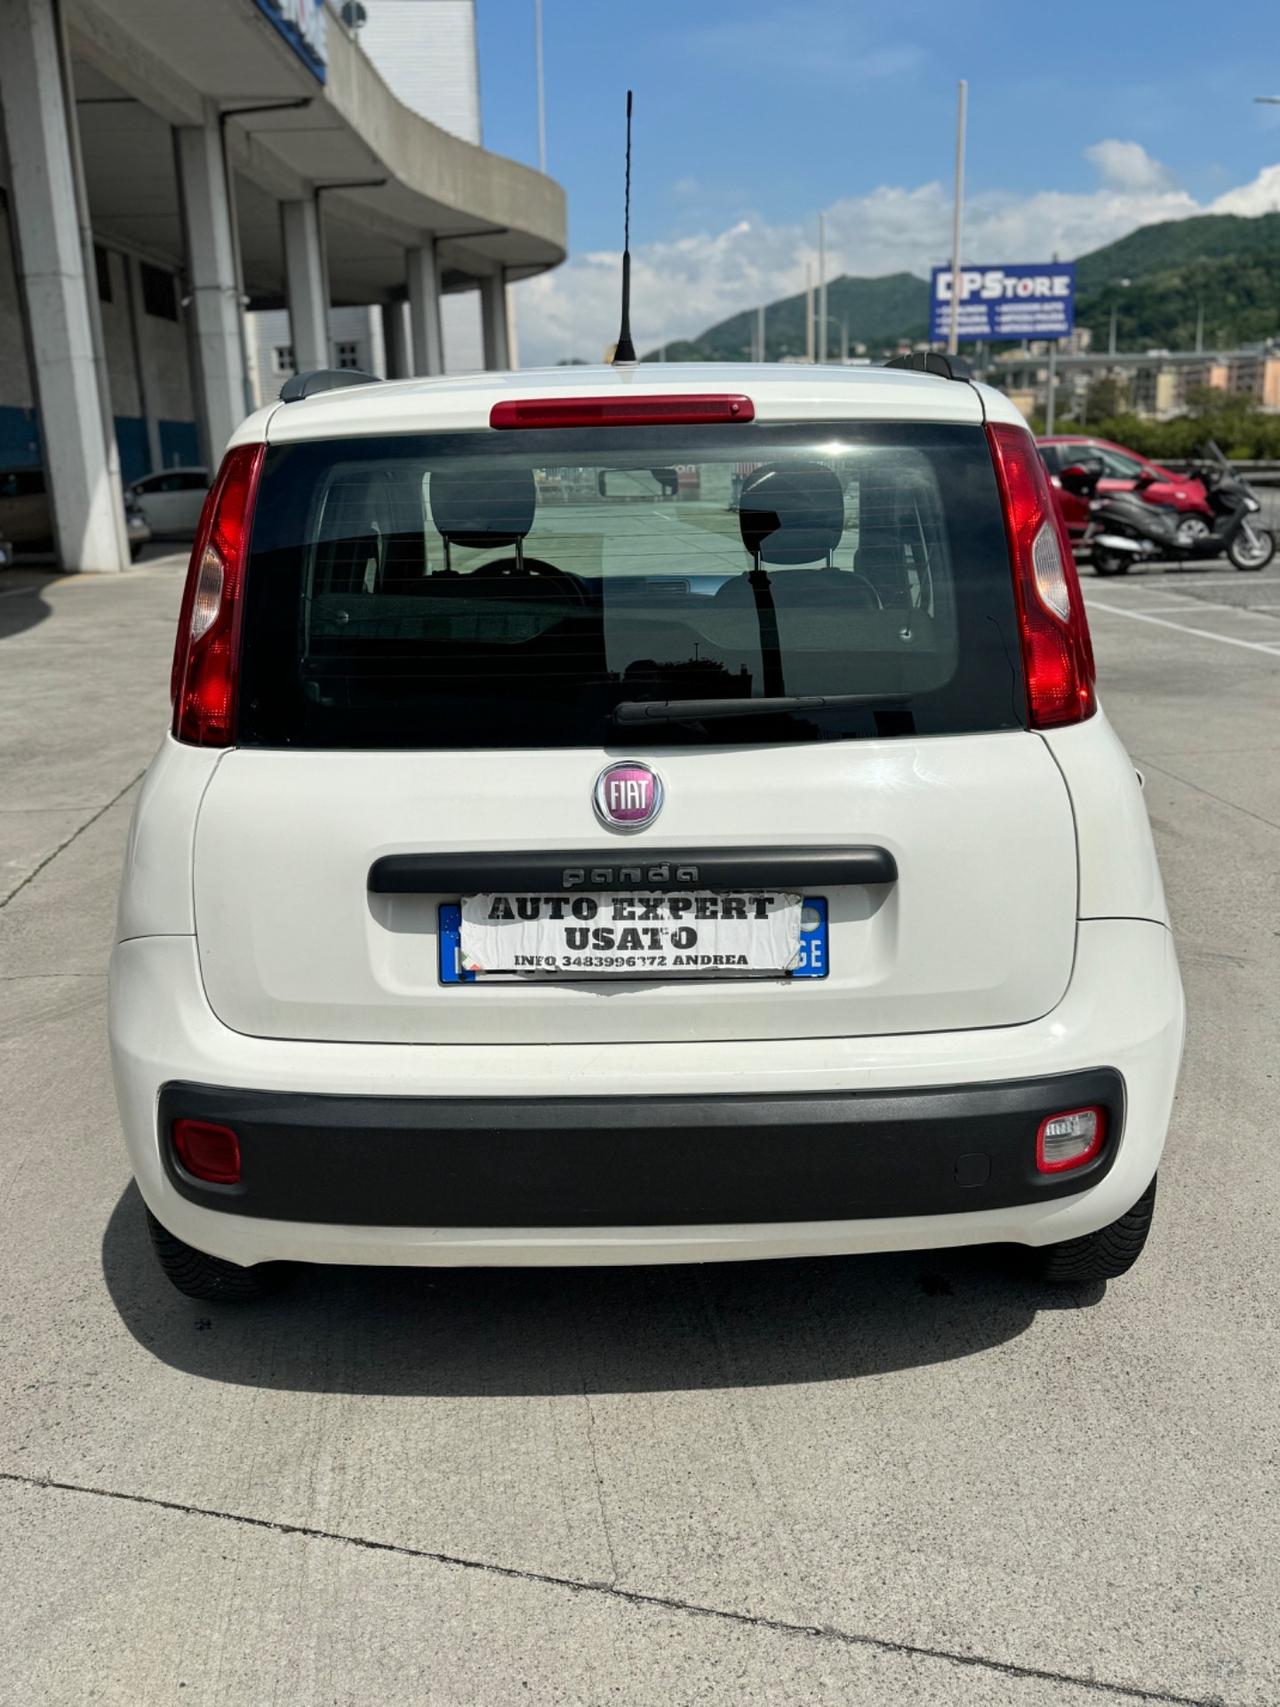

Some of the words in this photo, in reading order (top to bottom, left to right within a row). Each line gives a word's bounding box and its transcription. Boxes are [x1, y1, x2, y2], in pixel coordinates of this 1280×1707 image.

[610, 780, 649, 810] FIAT
[562, 863, 699, 888] panda
[488, 897, 598, 920] AUTO
[612, 897, 775, 921] EXPERT
[564, 926, 698, 950] USATO
[514, 954, 556, 967] INFO
[673, 954, 749, 966] ANDREA
